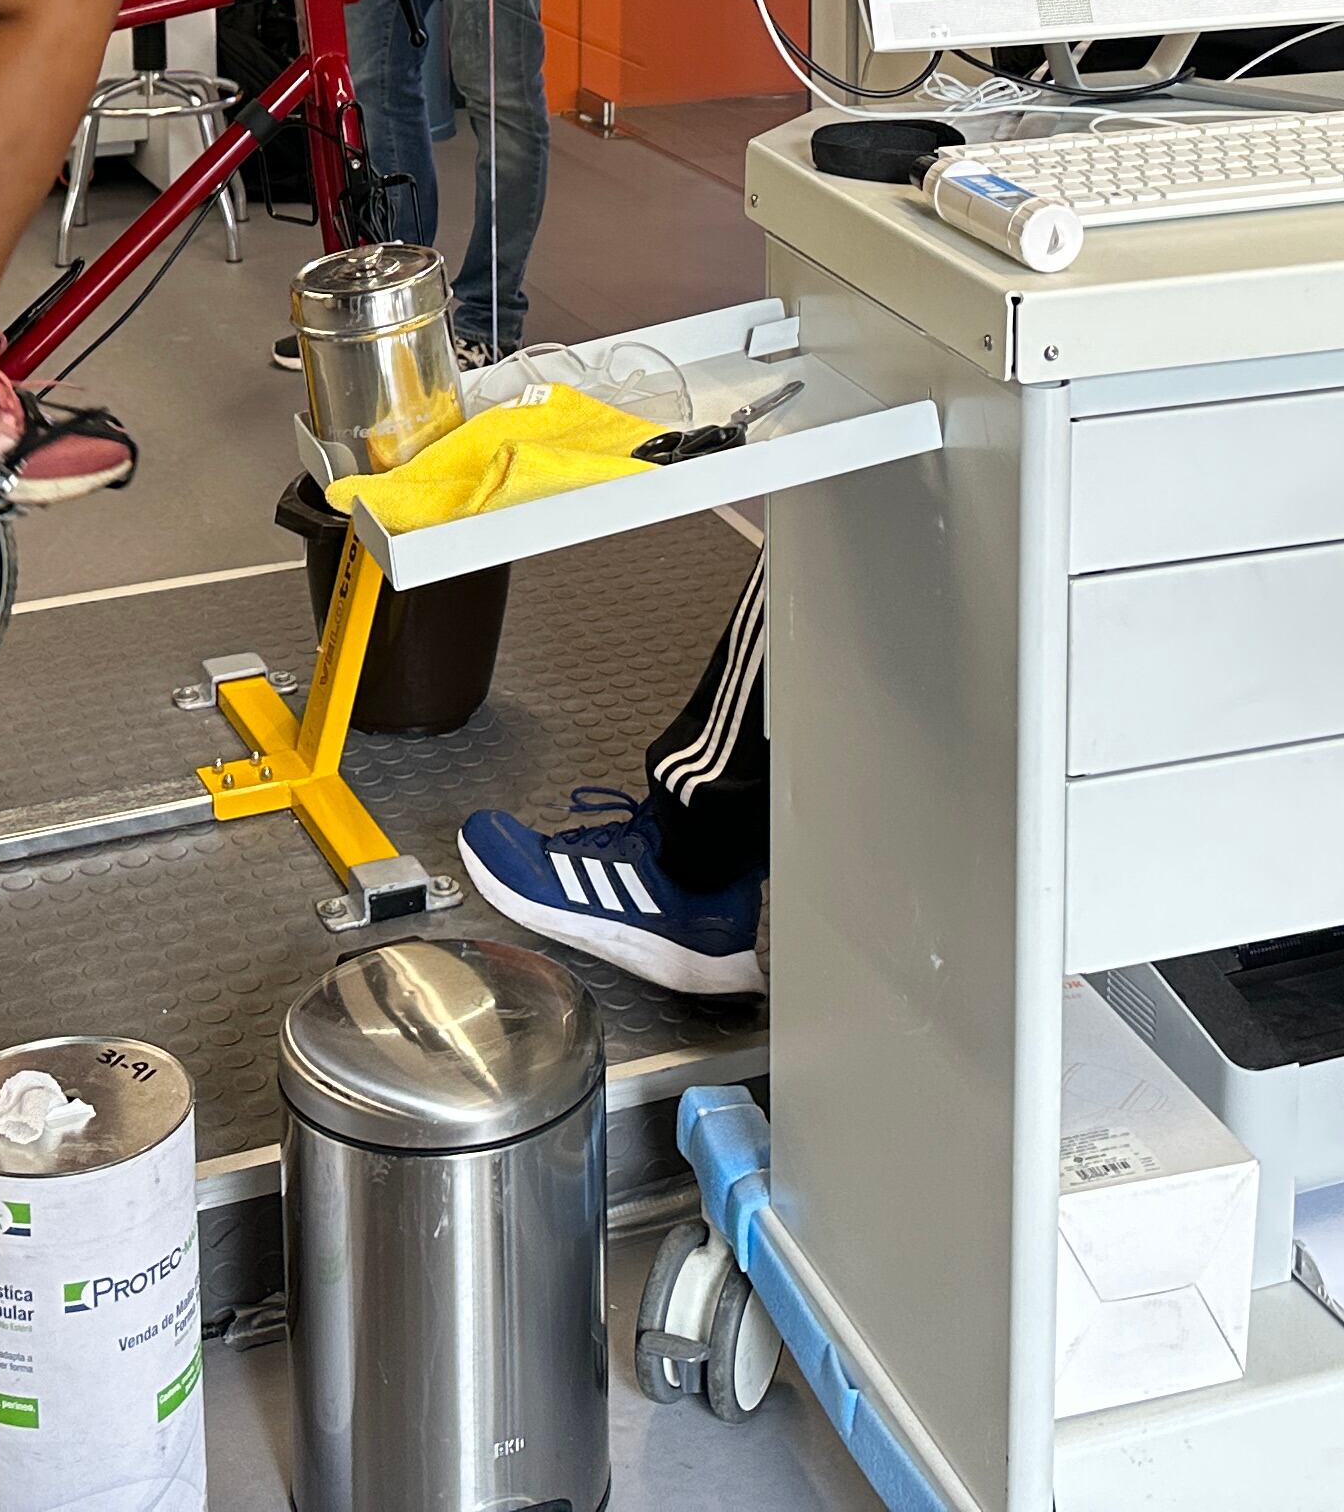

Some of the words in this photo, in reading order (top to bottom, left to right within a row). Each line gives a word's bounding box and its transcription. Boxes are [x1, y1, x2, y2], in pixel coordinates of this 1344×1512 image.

[118, 1324, 158, 1352] Venda
[161, 1313, 174, 1330] de
[10, 1362, 34, 1373] forma
